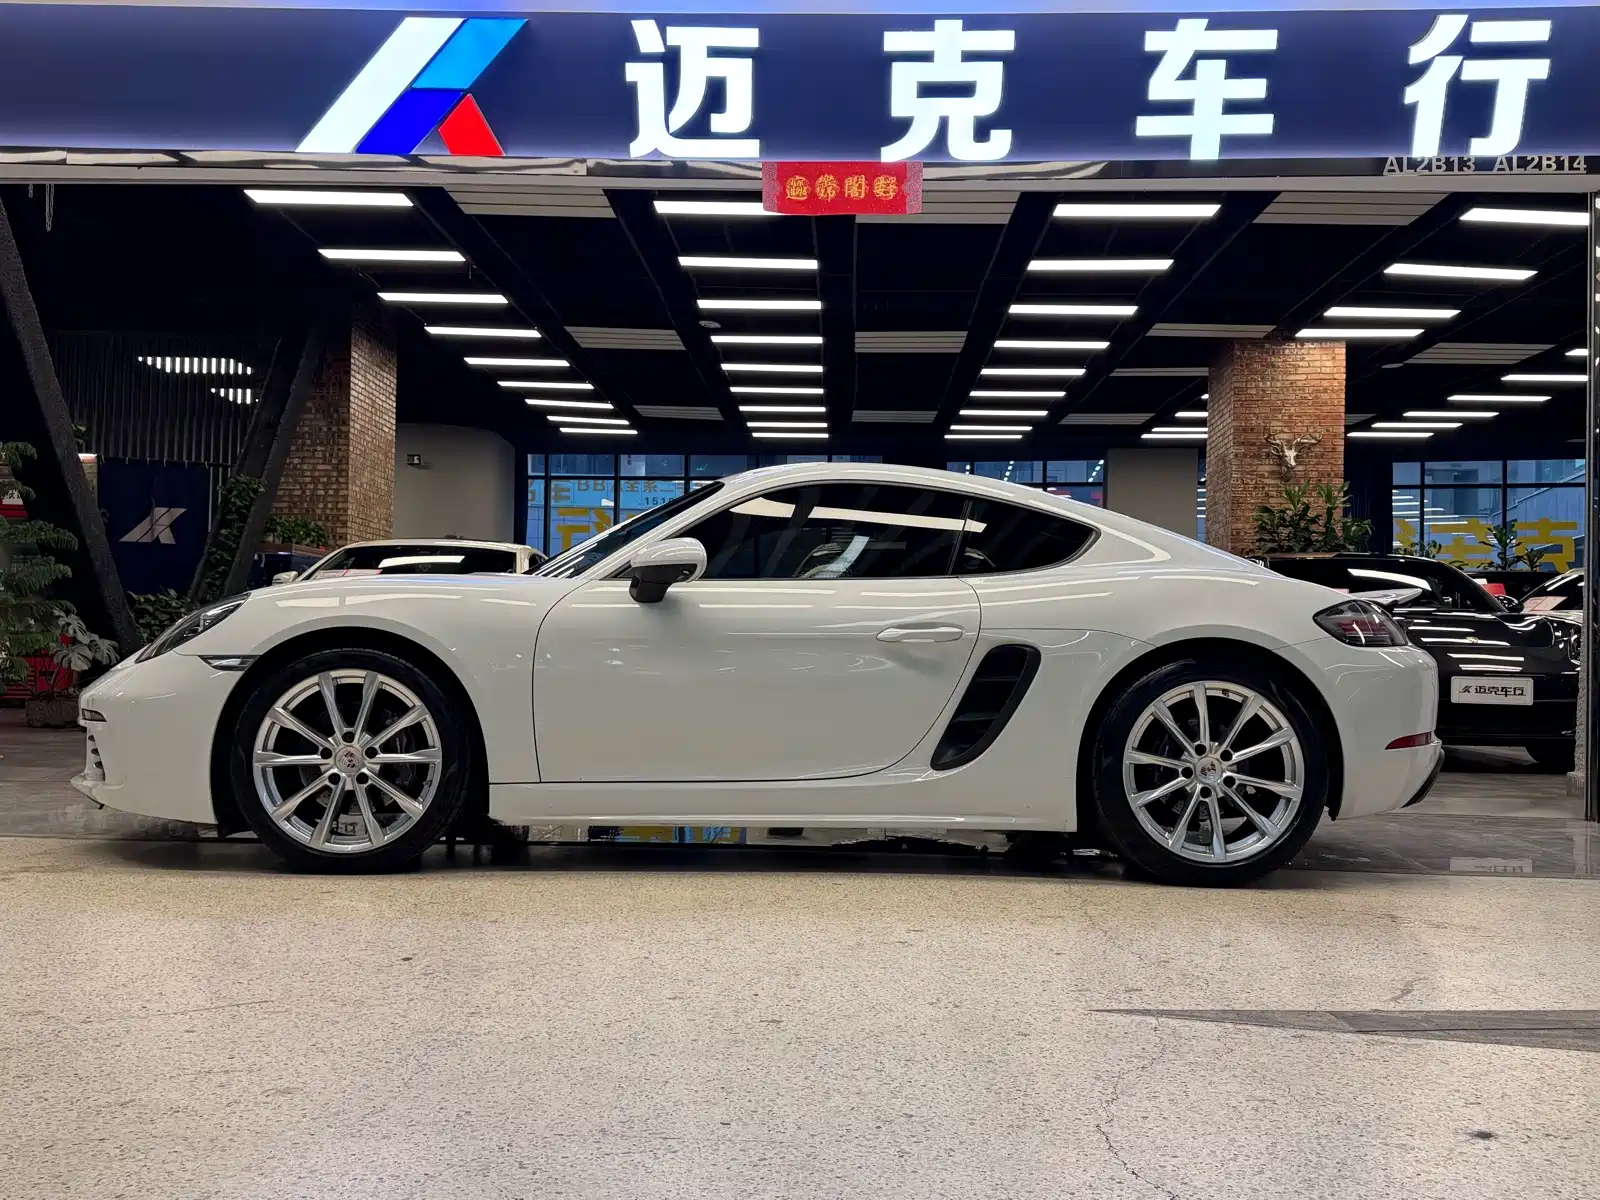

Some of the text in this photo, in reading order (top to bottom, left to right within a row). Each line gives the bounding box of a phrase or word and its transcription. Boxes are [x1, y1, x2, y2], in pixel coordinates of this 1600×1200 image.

[625, 14, 1552, 162] 迈克车行
[1383, 155, 1587, 174] AL2B13 AL2B14
[1474, 685, 1527, 698] 迈克车行
